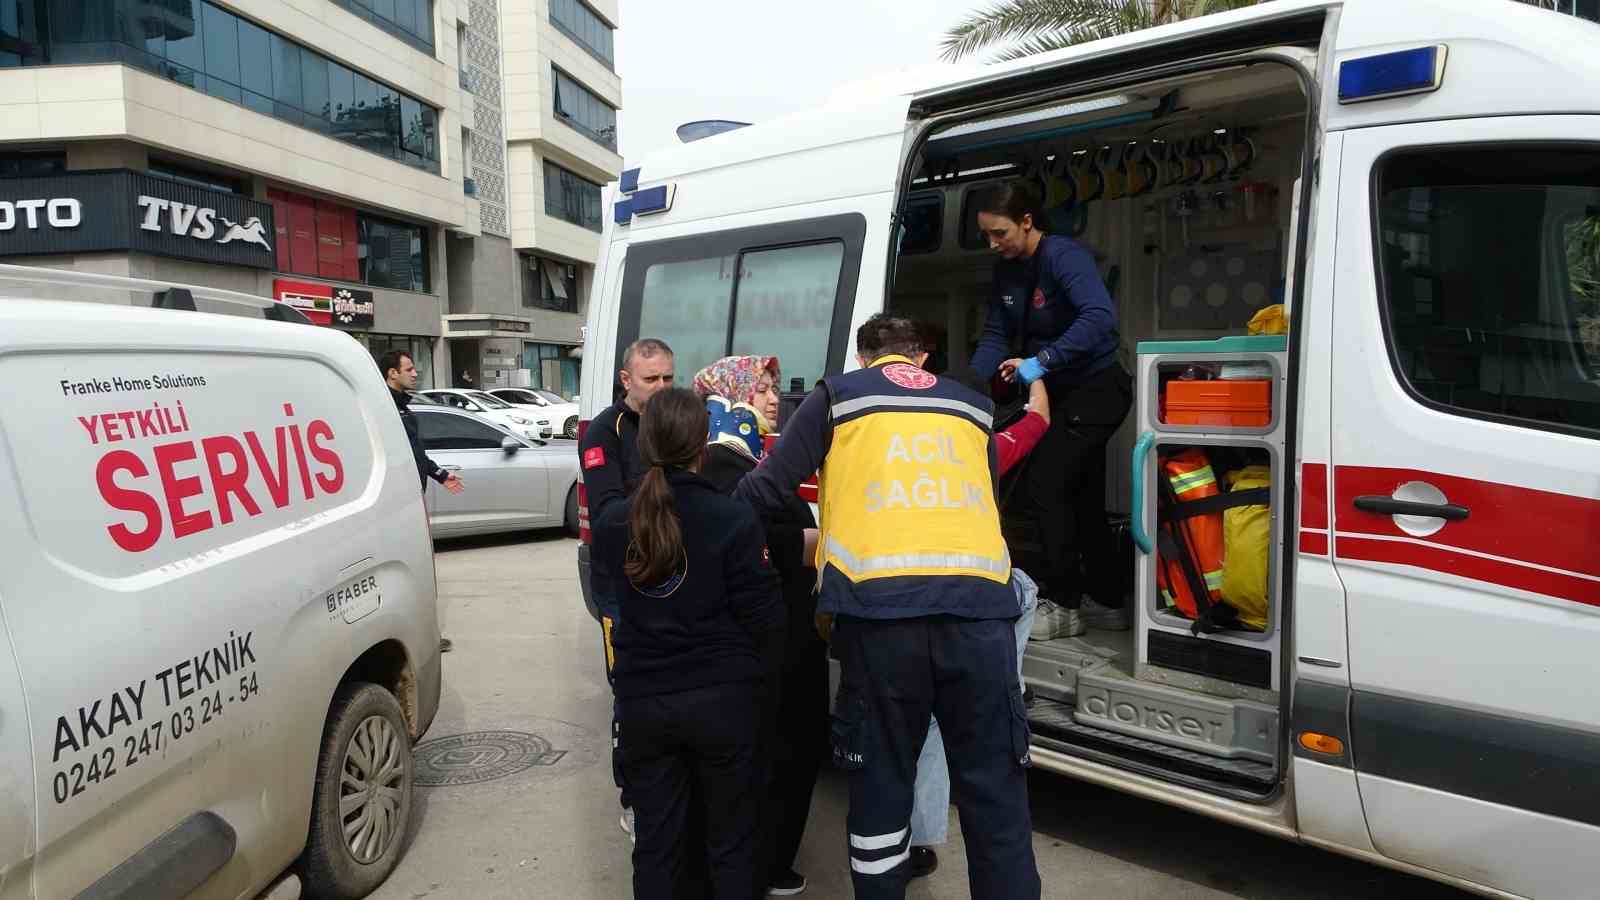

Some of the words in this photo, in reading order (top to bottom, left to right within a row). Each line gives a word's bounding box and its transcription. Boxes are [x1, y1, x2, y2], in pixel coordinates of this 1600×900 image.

[138, 195, 216, 240] TVS
[61, 377, 111, 396] Franke
[113, 374, 152, 392] Home
[153, 373, 207, 389] Solutions
[77, 400, 190, 445] YETKİLİ
[886, 427, 965, 465] ACİL
[95, 403, 344, 553] SERVİS
[864, 472, 988, 514] SAĞLIK
[337, 575, 378, 606] FABER
[53, 680, 147, 762] AKAY
[156, 630, 256, 706] TEKNİK
[1083, 689, 1223, 742] dorser
[53, 747, 117, 804] 0242
[124, 721, 163, 767] 247
[171, 706, 196, 740] 03
[201, 689, 224, 725] 24
[239, 671, 259, 702] 54
